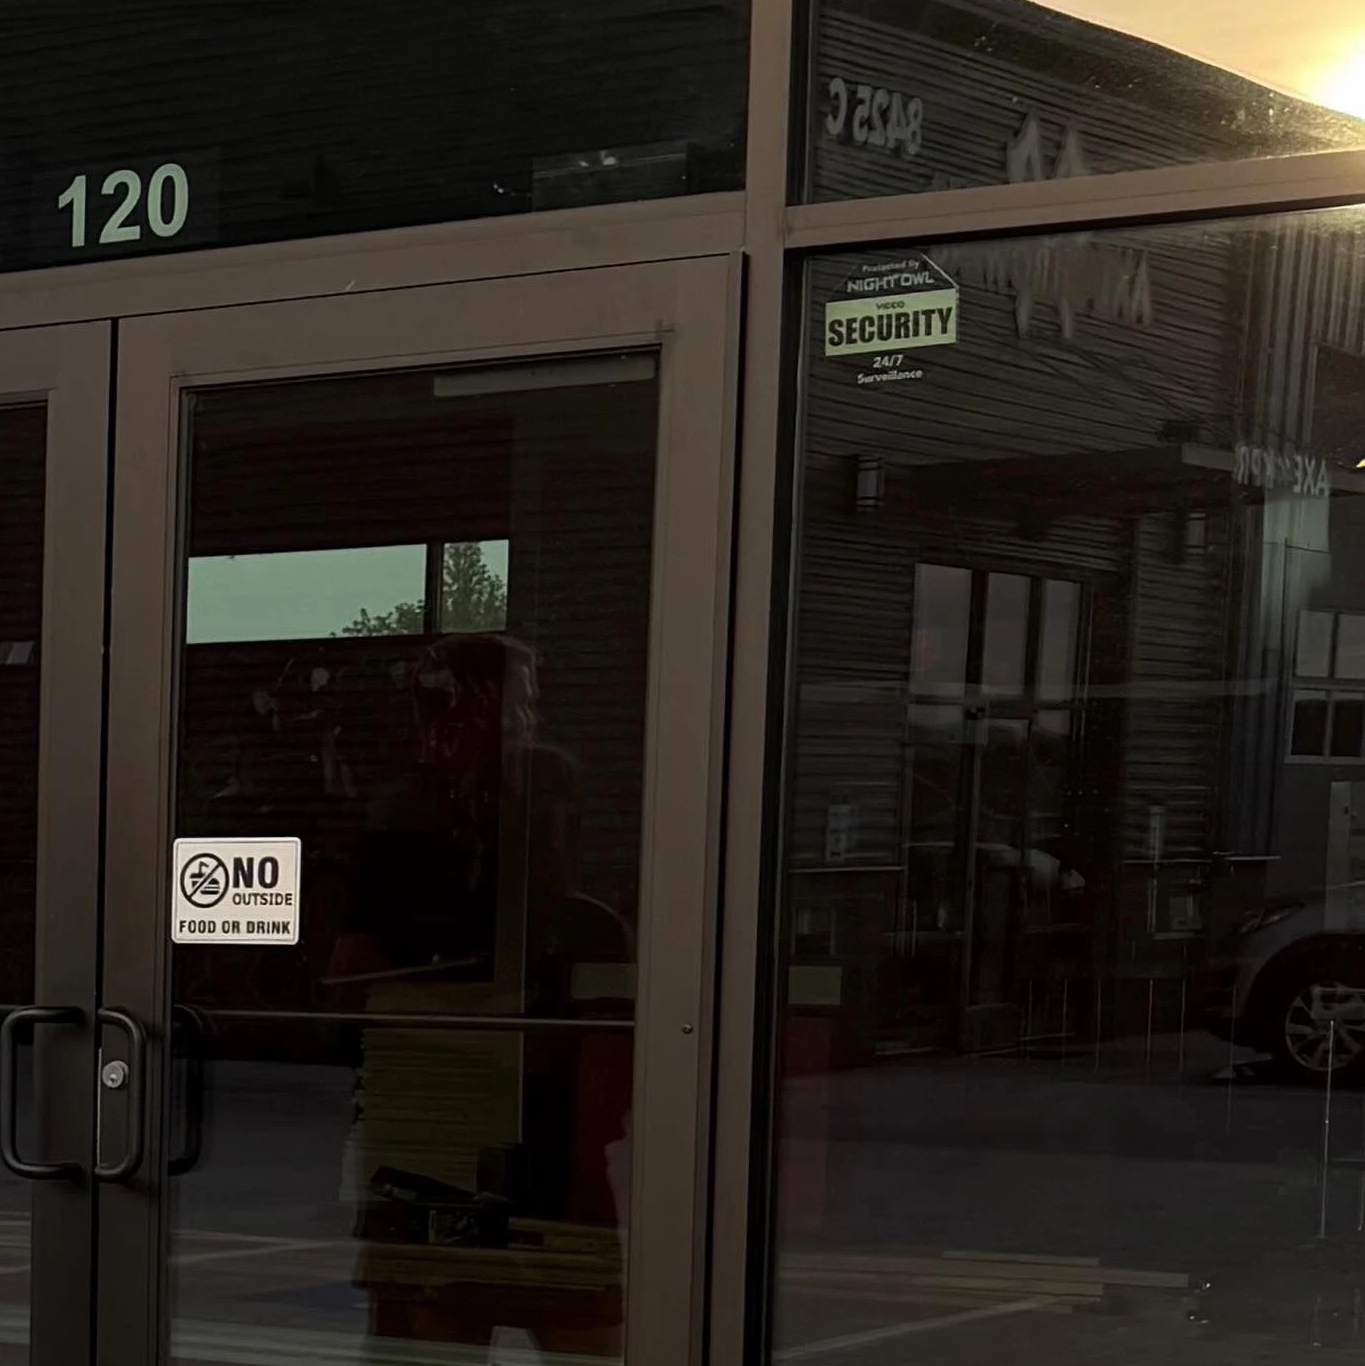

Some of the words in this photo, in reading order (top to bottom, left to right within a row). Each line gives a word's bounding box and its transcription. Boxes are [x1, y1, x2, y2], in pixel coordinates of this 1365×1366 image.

[58, 163, 189, 248] 120
[828, 306, 953, 347] SECURITY
[873, 354, 904, 368] 24/7
[232, 856, 279, 889] NO
[232, 892, 293, 906] OUTSIDE
[179, 920, 216, 934] FOOD
[221, 920, 241, 934] OR
[246, 920, 291, 934] DRINK
